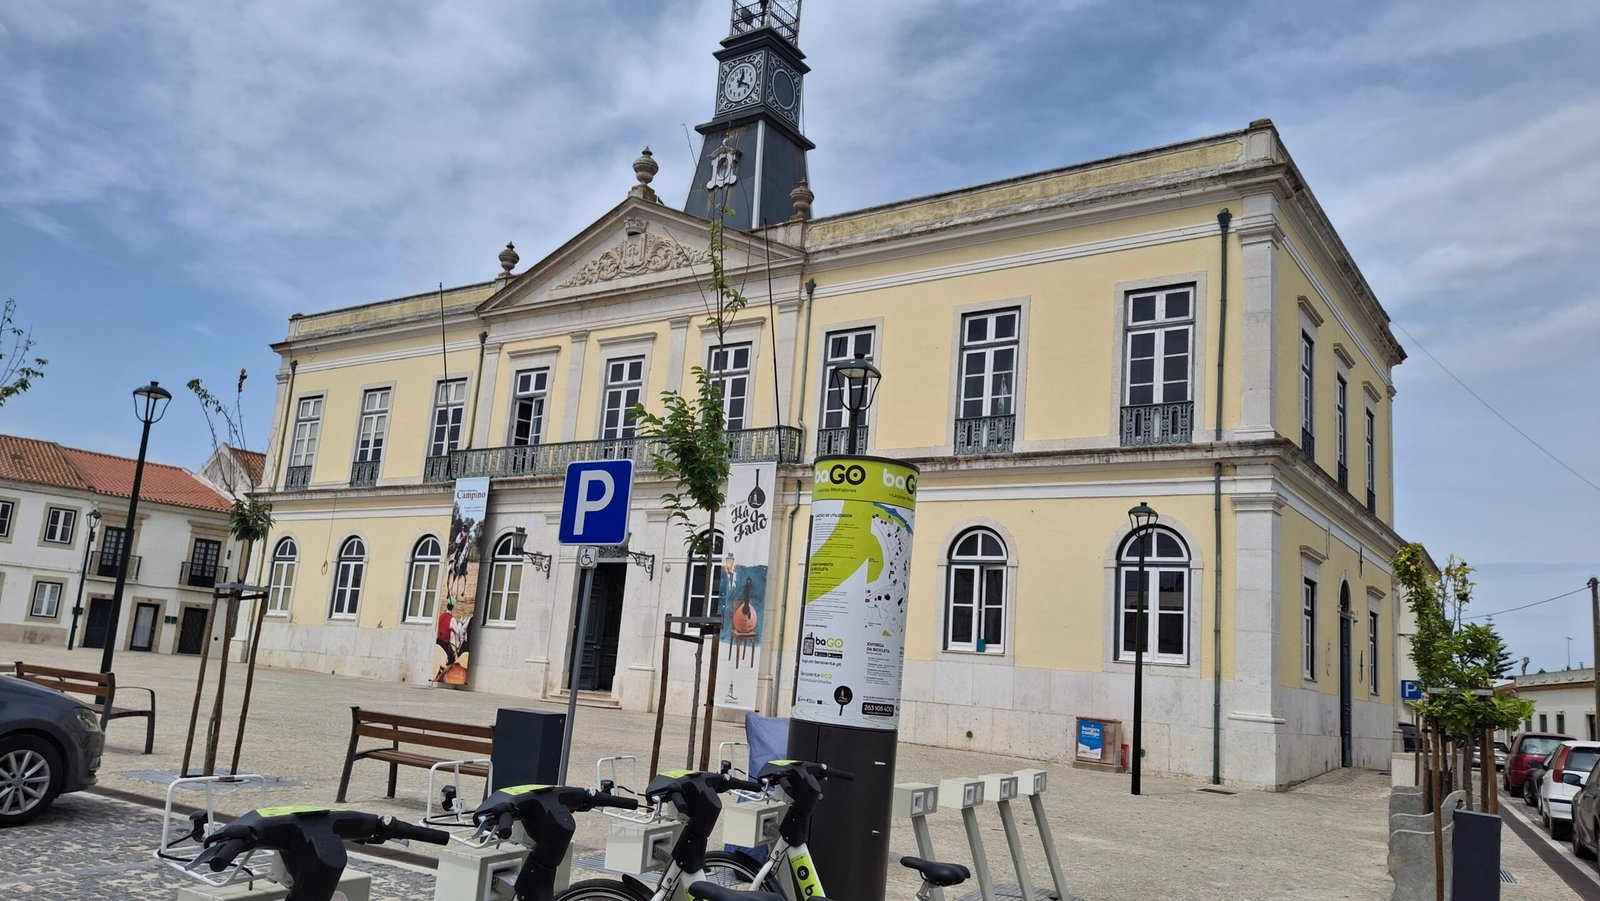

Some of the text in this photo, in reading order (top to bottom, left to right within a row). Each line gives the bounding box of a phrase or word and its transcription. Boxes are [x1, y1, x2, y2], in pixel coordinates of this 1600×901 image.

[815, 464, 866, 485] baGO
[883, 468, 917, 495] baG
[457, 490, 486, 500] Campino
[573, 469, 615, 536] P
[731, 505, 749, 524] Há
[734, 510, 768, 543] Fado
[815, 636, 844, 648] baGO
[1404, 682, 1417, 698] P
